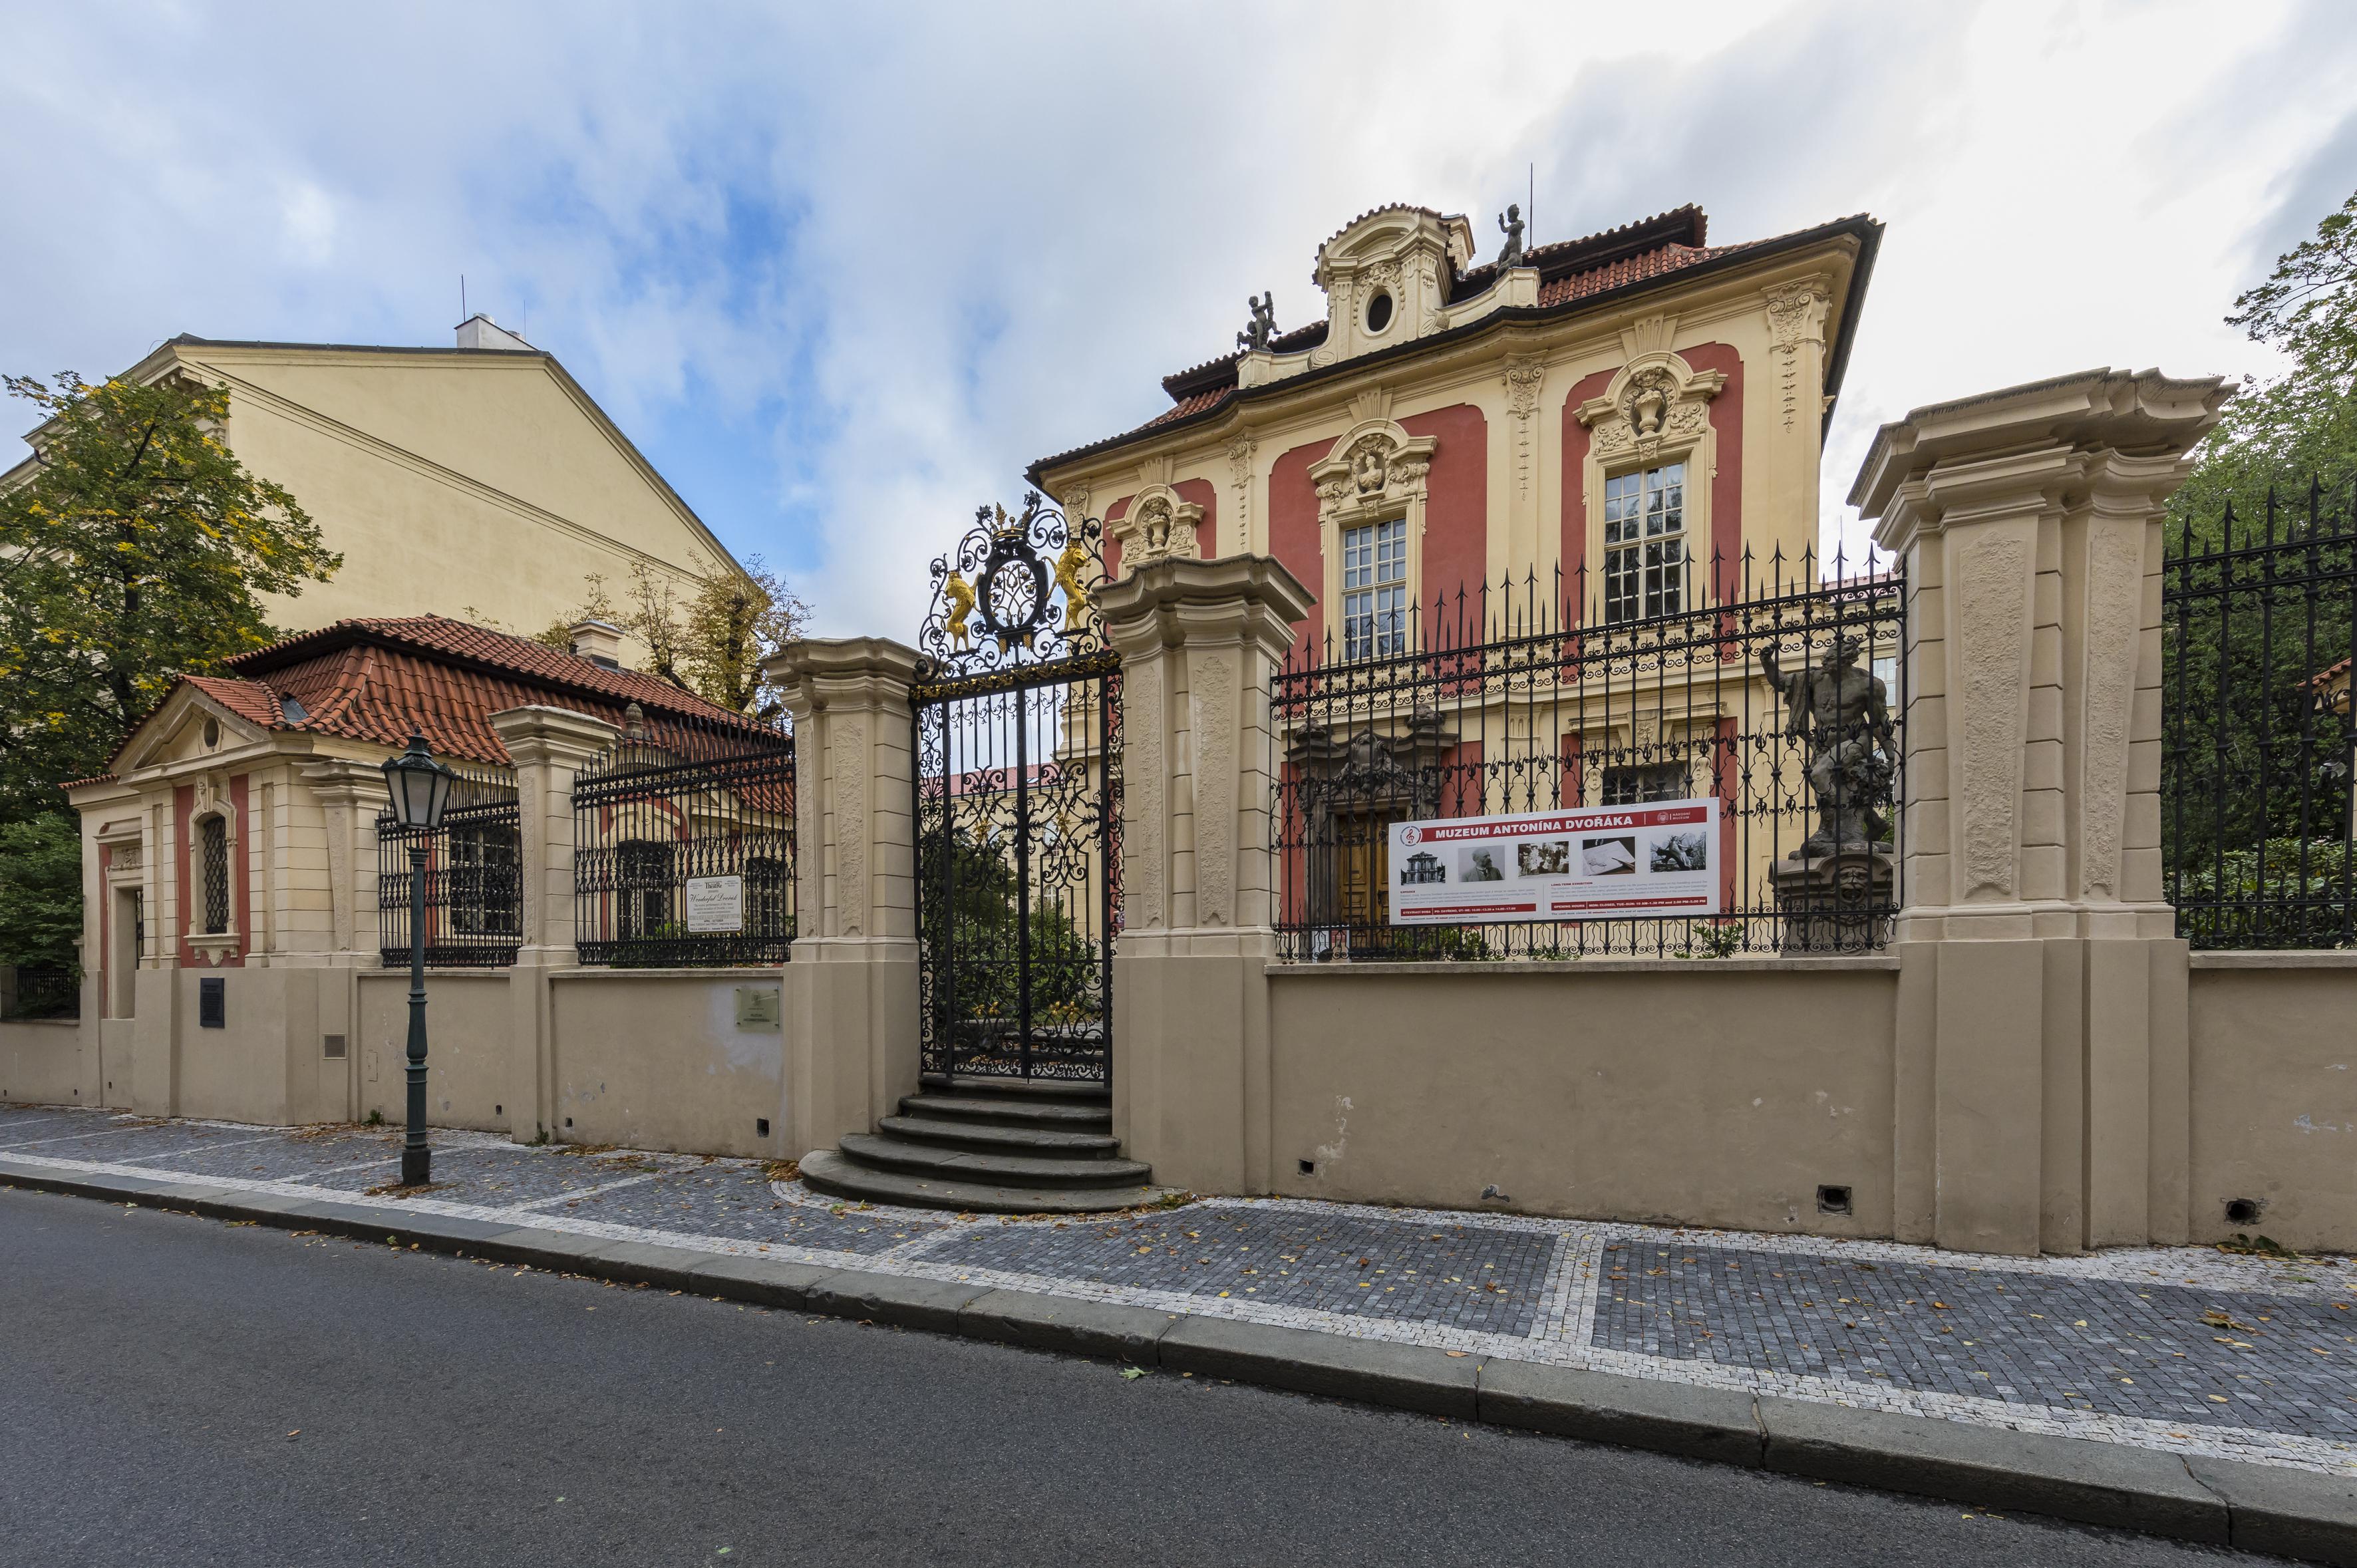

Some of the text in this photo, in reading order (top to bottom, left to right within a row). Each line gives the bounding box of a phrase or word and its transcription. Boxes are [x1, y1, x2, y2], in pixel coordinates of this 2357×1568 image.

[1436, 816, 1633, 839] MUZEUM ANTONÍNA DVOŘÁKA
[690, 894, 717, 903] Wonderful
